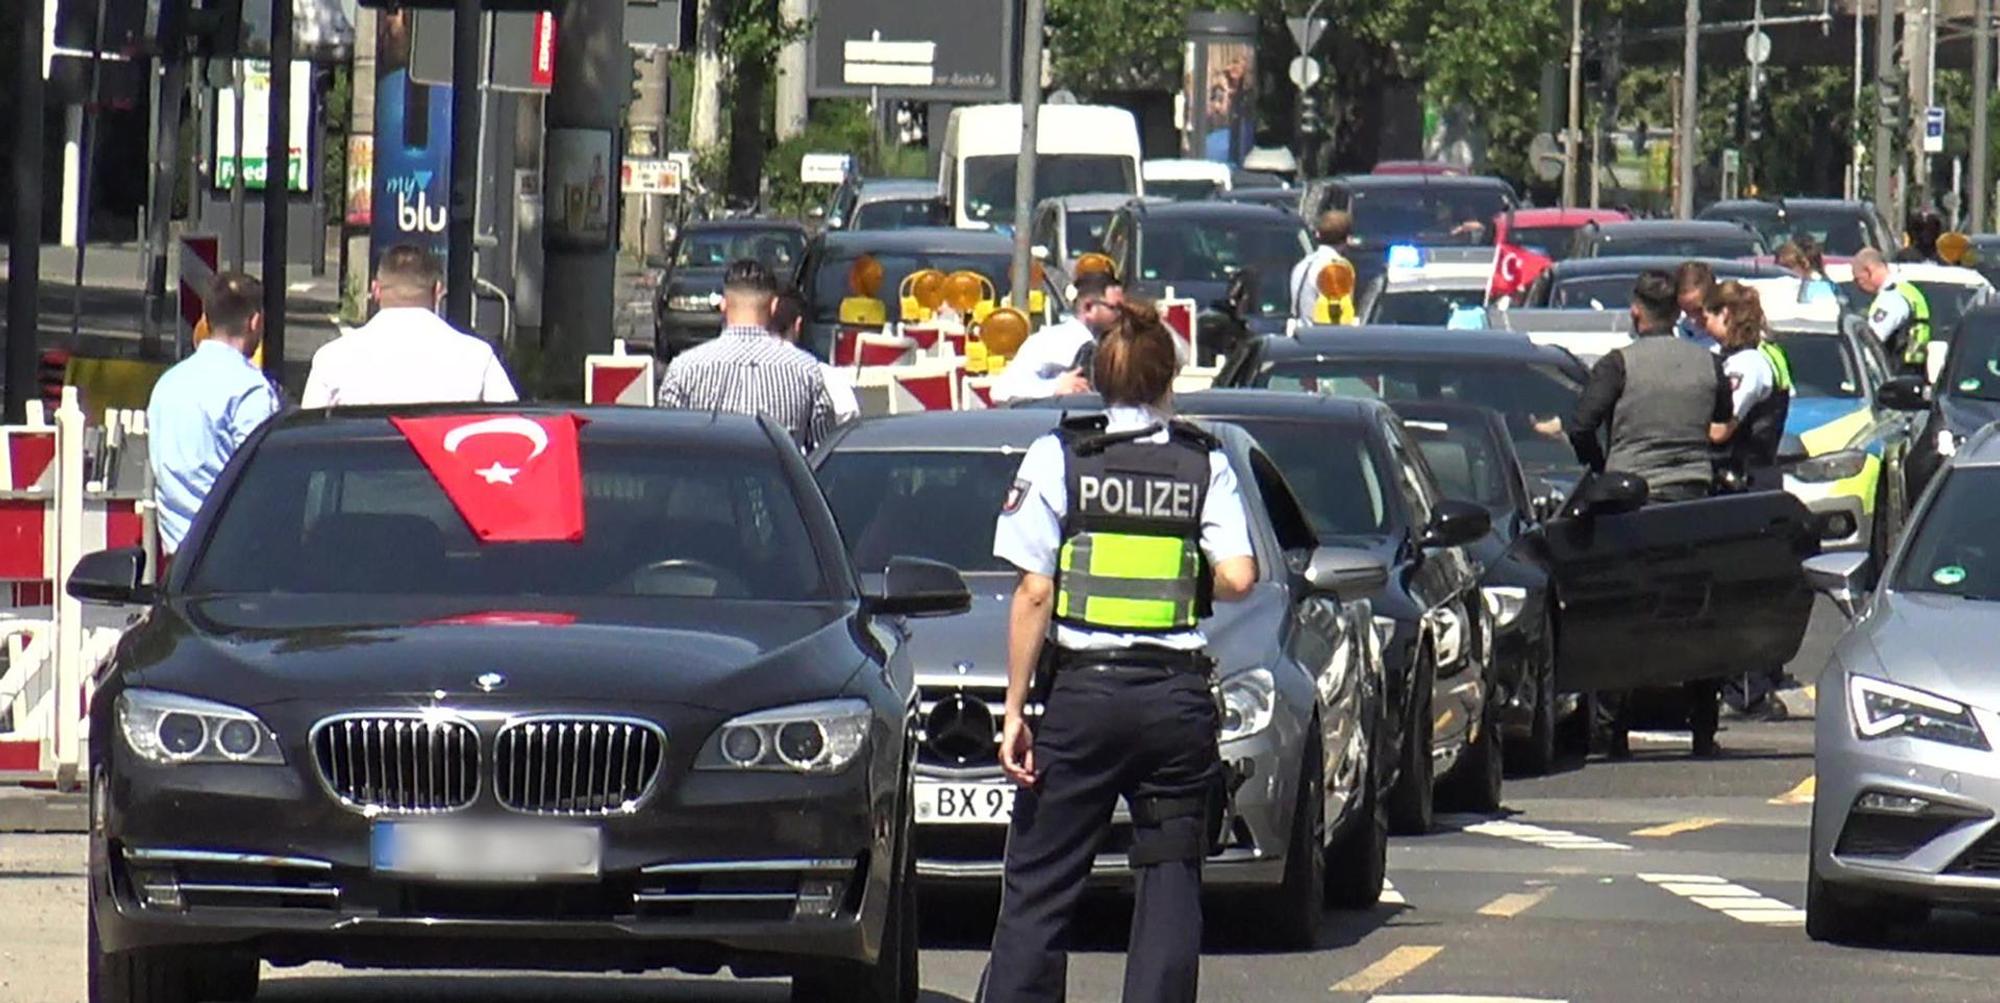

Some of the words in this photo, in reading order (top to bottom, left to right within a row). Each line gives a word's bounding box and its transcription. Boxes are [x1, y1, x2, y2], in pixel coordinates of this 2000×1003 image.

[398, 190, 447, 232] blu
[1079, 475, 1198, 518] POLIZEI
[937, 787, 977, 818] BX
